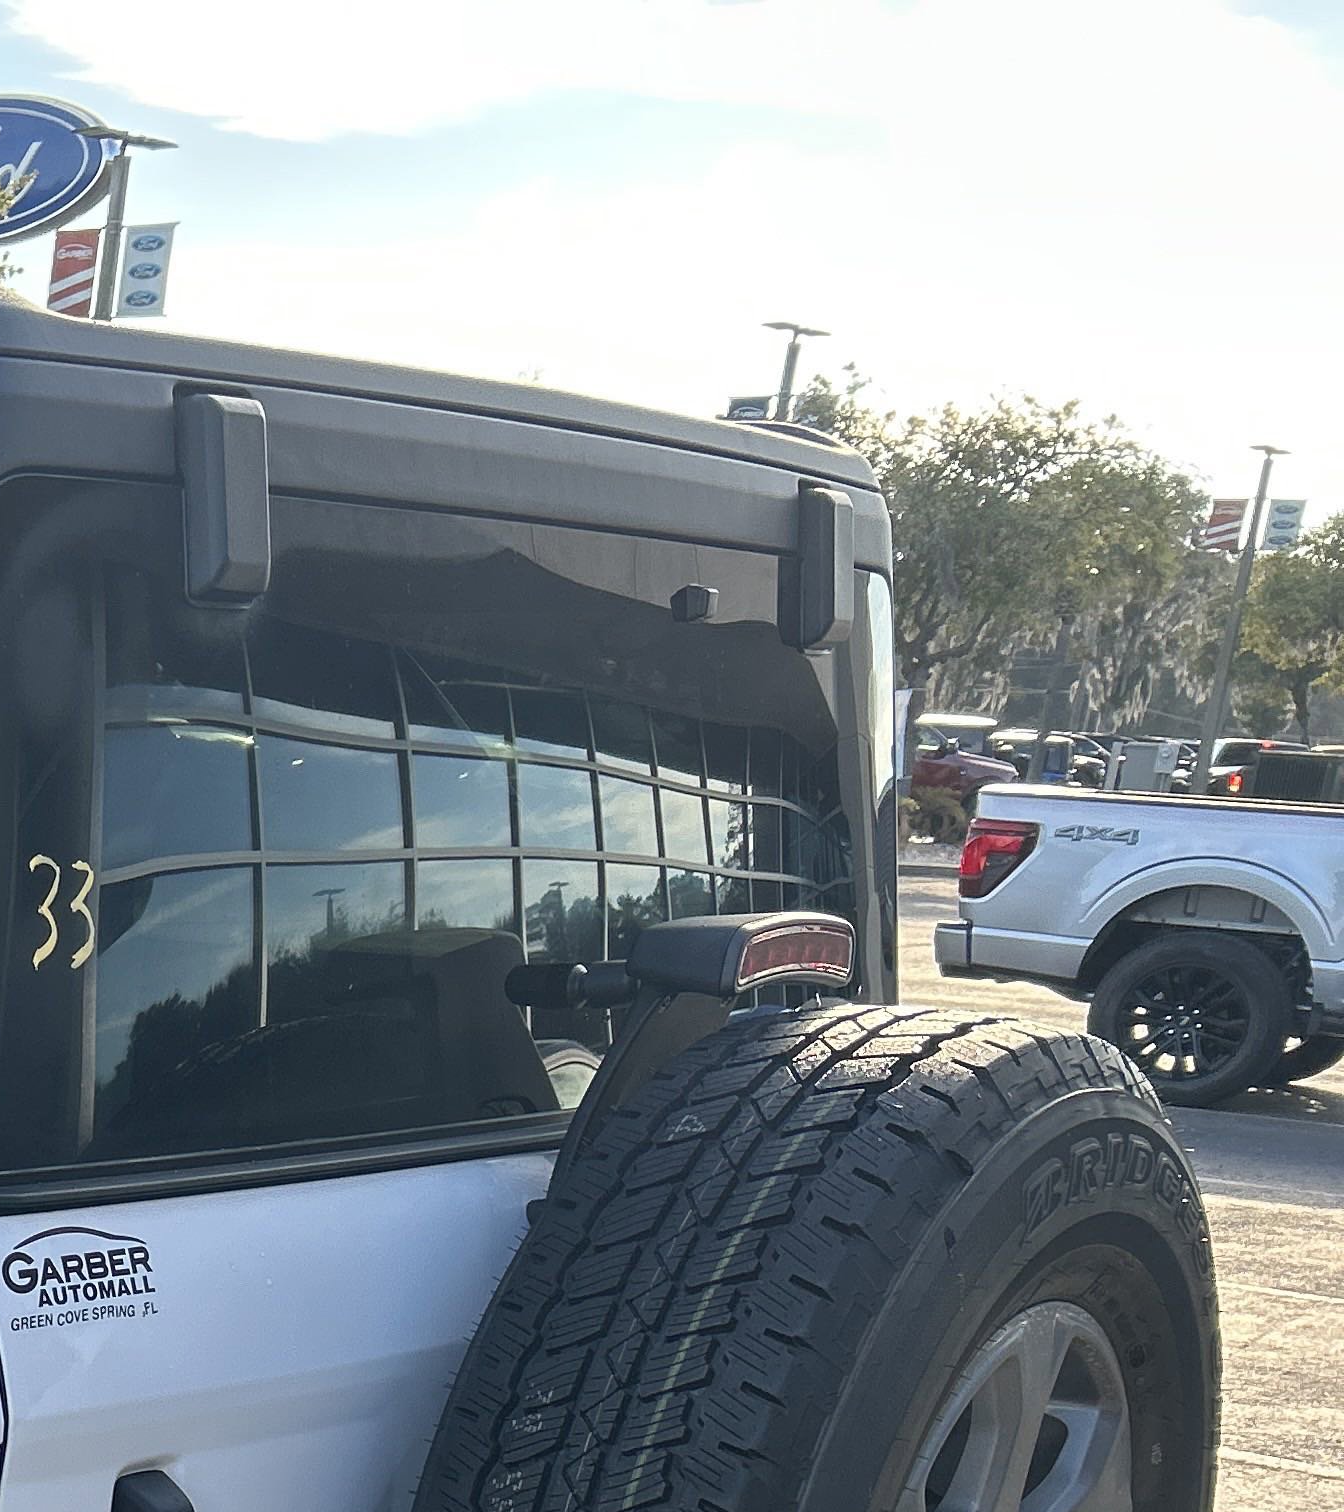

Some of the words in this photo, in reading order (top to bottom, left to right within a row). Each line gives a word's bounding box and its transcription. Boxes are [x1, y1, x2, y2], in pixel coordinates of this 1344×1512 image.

[29, 854, 95, 971] 33
[1, 1246, 153, 1294] GARBER
[38, 1275, 156, 1308] AUTOMALL
[10, 1313, 54, 1331] GREEN
[56, 1308, 89, 1327] COVE
[91, 1304, 136, 1320] SPRING
